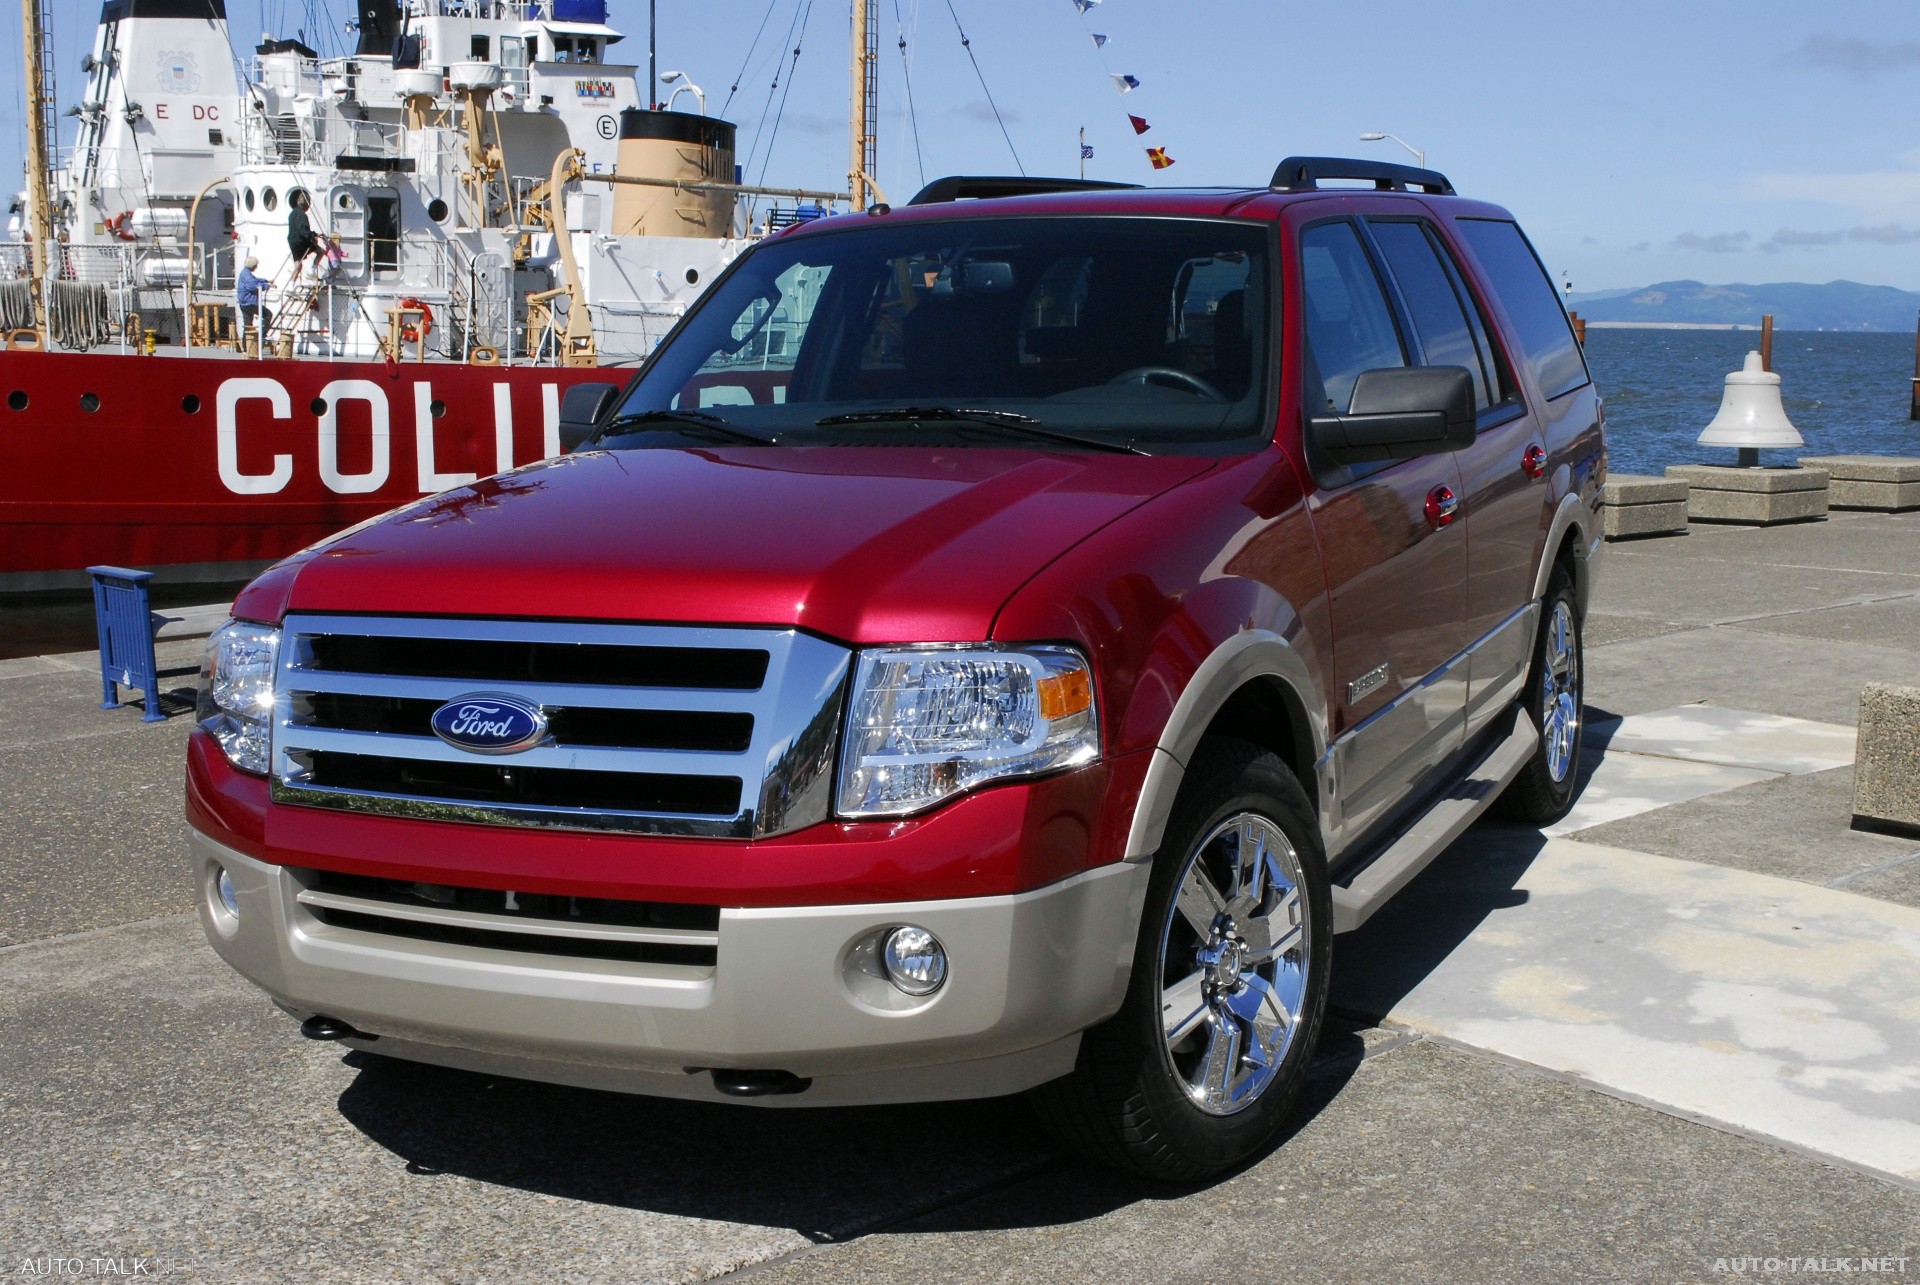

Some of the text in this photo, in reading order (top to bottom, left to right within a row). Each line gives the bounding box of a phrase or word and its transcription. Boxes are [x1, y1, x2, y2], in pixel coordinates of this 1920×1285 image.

[156, 103, 219, 121] E DC
[450, 704, 514, 738] Ford
